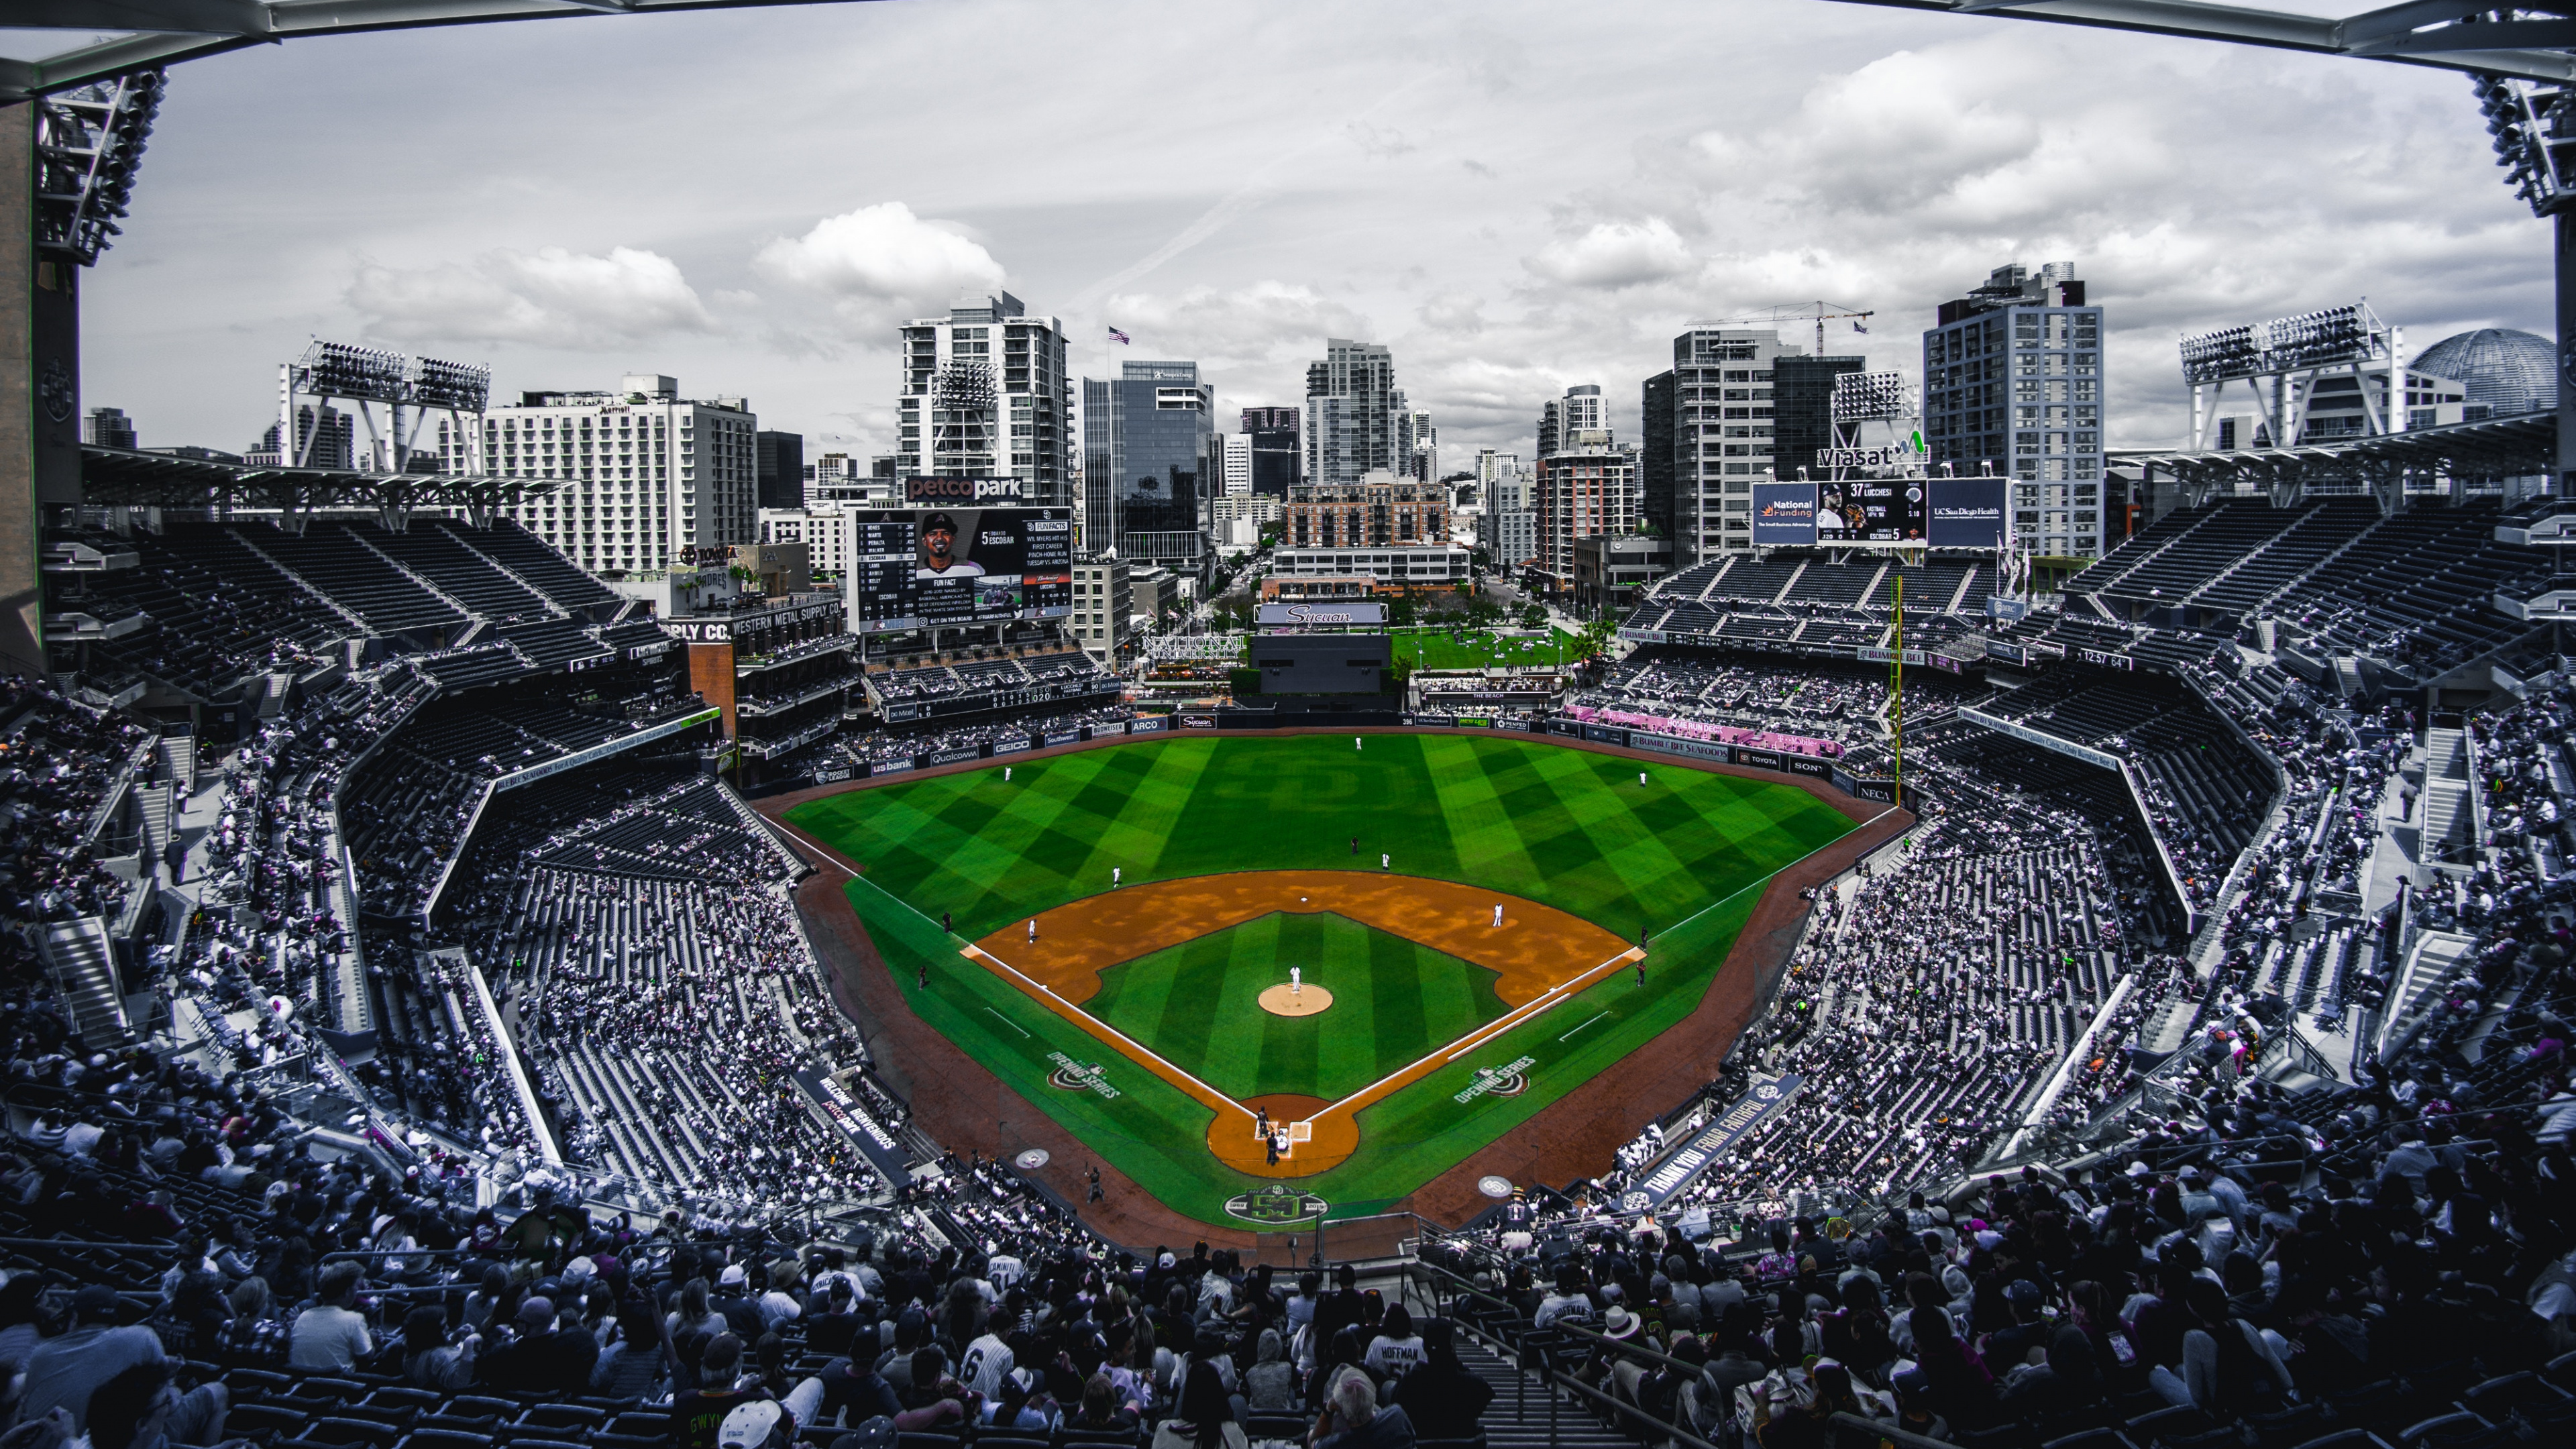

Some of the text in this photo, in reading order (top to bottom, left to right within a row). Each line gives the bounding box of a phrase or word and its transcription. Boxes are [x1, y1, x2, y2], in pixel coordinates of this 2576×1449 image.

[1819, 446, 1892, 468] Viasat
[1850, 483, 1864, 497] 37
[1864, 488, 1892, 496] LUCCHESI
[1774, 500, 1813, 508] National
[1774, 509, 1813, 517] Funding
[1958, 508, 1977, 516] Diego
[982, 531, 988, 545] 5
[1892, 528, 1899, 540] 5
[989, 536, 1014, 545] ESCOBAR
[697, 547, 737, 561] TOYOTA
[2002, 605, 2015, 613] MRC
[733, 603, 841, 635] WESTERN METAL SUPPLY CO.
[1286, 604, 1353, 628] Sycuan
[705, 625, 732, 640] CO.
[1625, 631, 1650, 639] BUMBLE
[1142, 635, 1247, 649] NATIONAL
[1149, 648, 1241, 659] UNIVERSITY
[1907, 652, 1923, 662] BEE
[2084, 651, 2126, 668] 12:57 64°
[642, 655, 663, 665] SPIRITS
[1133, 720, 1158, 731] ARCO
[1183, 716, 1211, 727] Sycuan
[1667, 719, 1723, 734] HOME RUN DECK
[1093, 724, 1122, 733] BUDWEISER
[1047, 735, 1074, 744] Southwest
[1988, 718, 2010, 733] SEAFOODS
[2028, 733, 2045, 744] Quality
[2078, 748, 2098, 763] Bumble
[2099, 756, 2110, 767] Bee
[996, 741, 1030, 752] GEICO
[1640, 737, 1728, 758] BUMBLE BEE SEAFOODS
[932, 751, 977, 763] Qualcomm
[1752, 757, 1777, 765] TOYOTA
[510, 776, 521, 786] BEE
[523, 765, 553, 781] SEAFOODS
[570, 755, 588, 766] Quality
[1794, 762, 1823, 772] SONY
[829, 773, 851, 782] LEAGUE
[1862, 788, 1890, 800] NECA
[1046, 1051, 1091, 1078] OPENING
[1454, 1074, 1503, 1104] OPENING
[1496, 1055, 1536, 1079] SERIES
[1081, 1075, 1121, 1099] SERIES
[819, 1076, 896, 1150] WELCOME BIENVENIDOS
[1644, 1099, 1768, 1194] THANK YOU FRIAR FAITHFUL
[988, 1262, 1016, 1273] CAMINITI
[1381, 1346, 1418, 1360] HOFFMAN
[963, 1348, 984, 1383] 6
